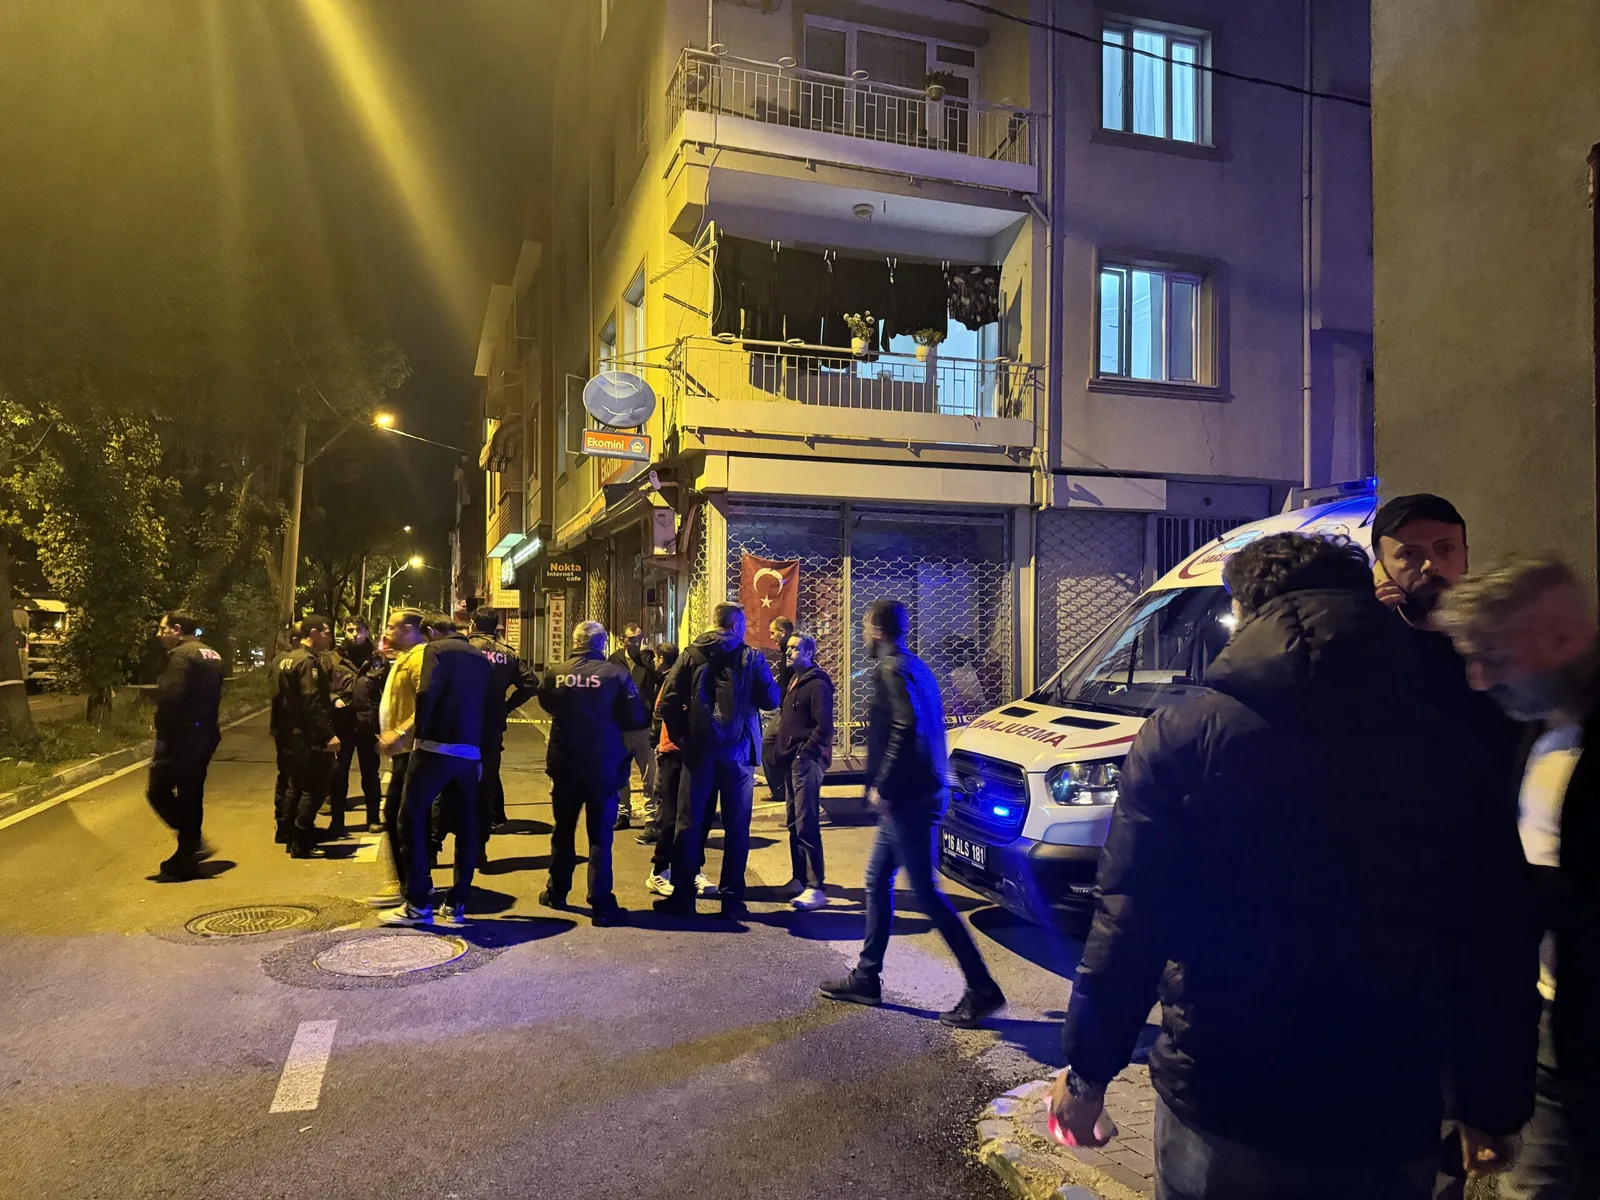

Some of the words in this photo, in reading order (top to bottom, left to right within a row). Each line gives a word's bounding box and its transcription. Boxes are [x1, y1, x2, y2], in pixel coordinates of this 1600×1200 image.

[587, 437, 624, 450] Ekomini
[550, 563, 581, 571] Nokta
[948, 834, 954, 850] 16
[956, 838, 970, 857] ALS
[972, 844, 984, 864] 181
